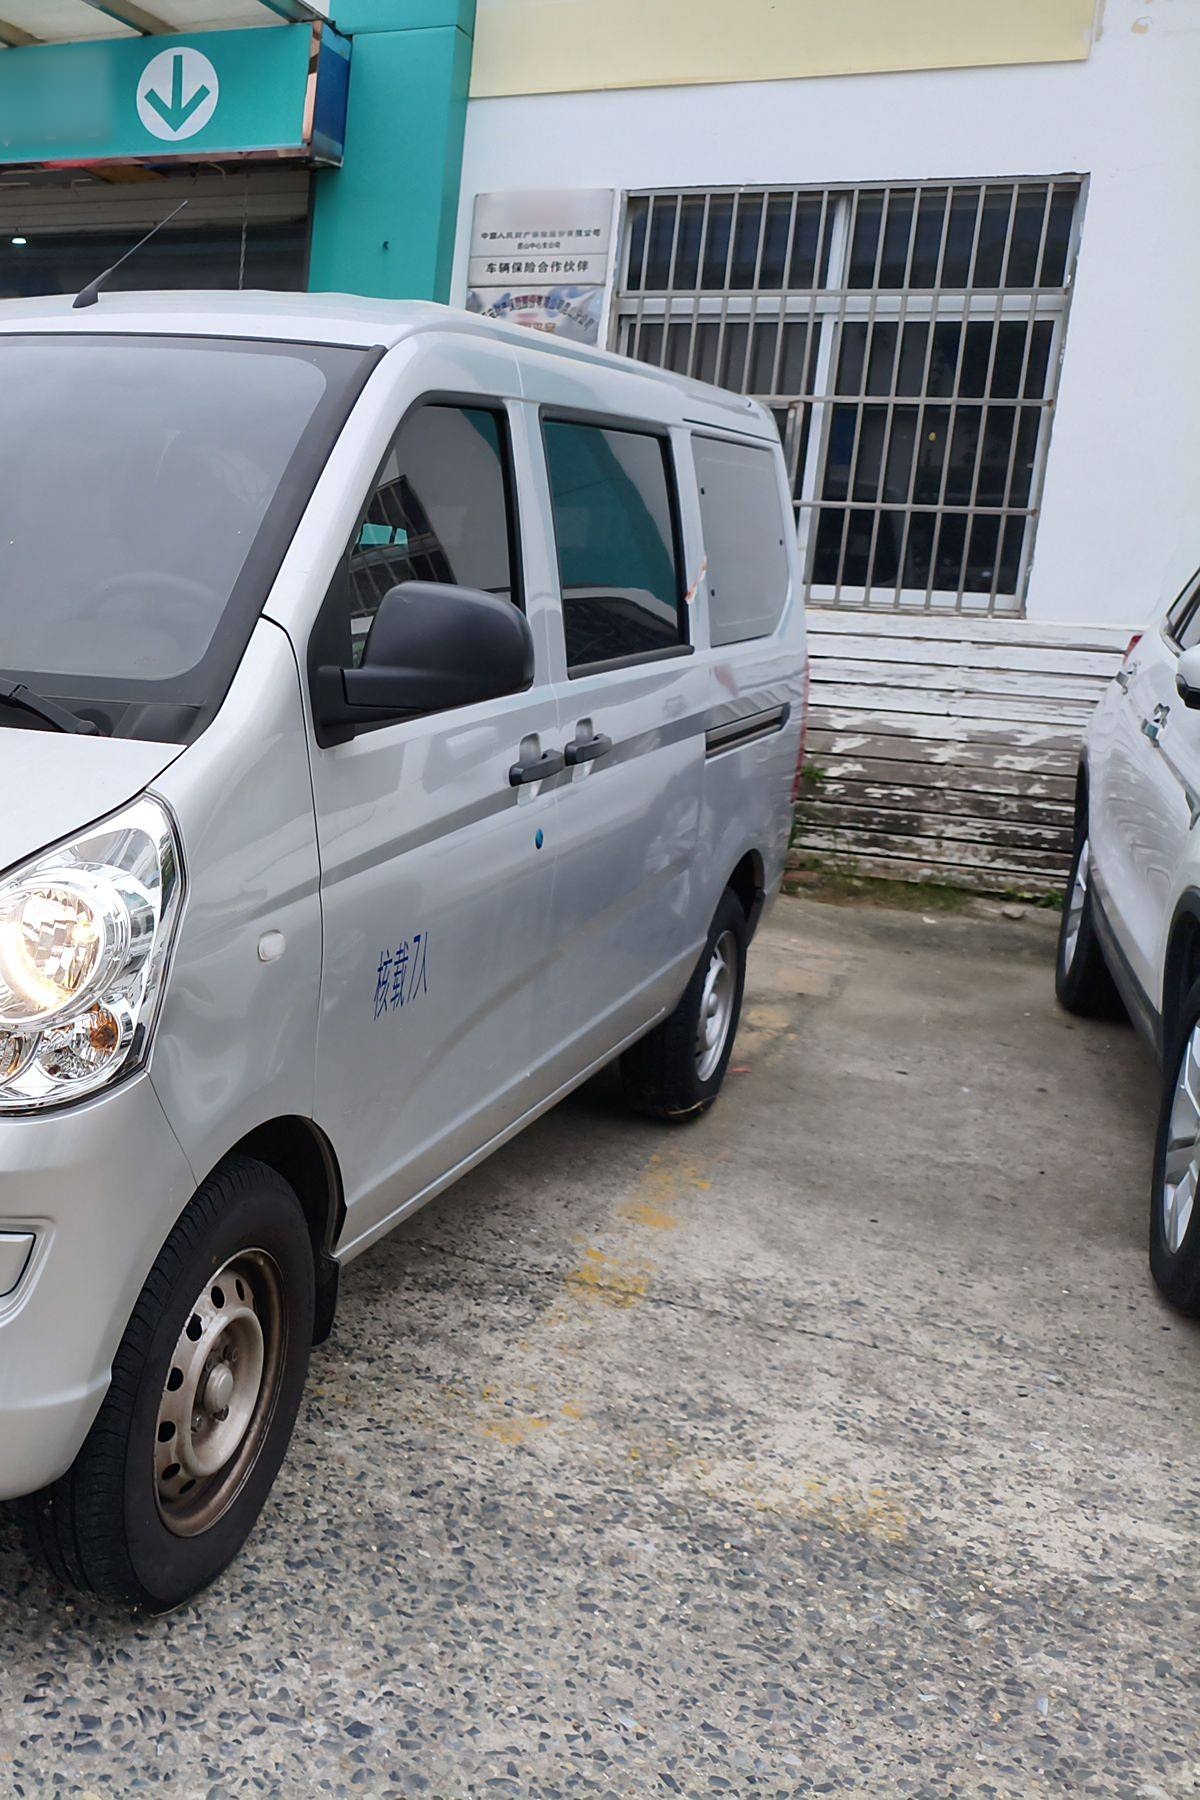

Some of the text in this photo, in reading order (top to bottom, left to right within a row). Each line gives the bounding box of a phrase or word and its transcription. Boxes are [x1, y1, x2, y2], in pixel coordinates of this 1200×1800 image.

[486, 260, 589, 275] 车辆保险合作伙伴
